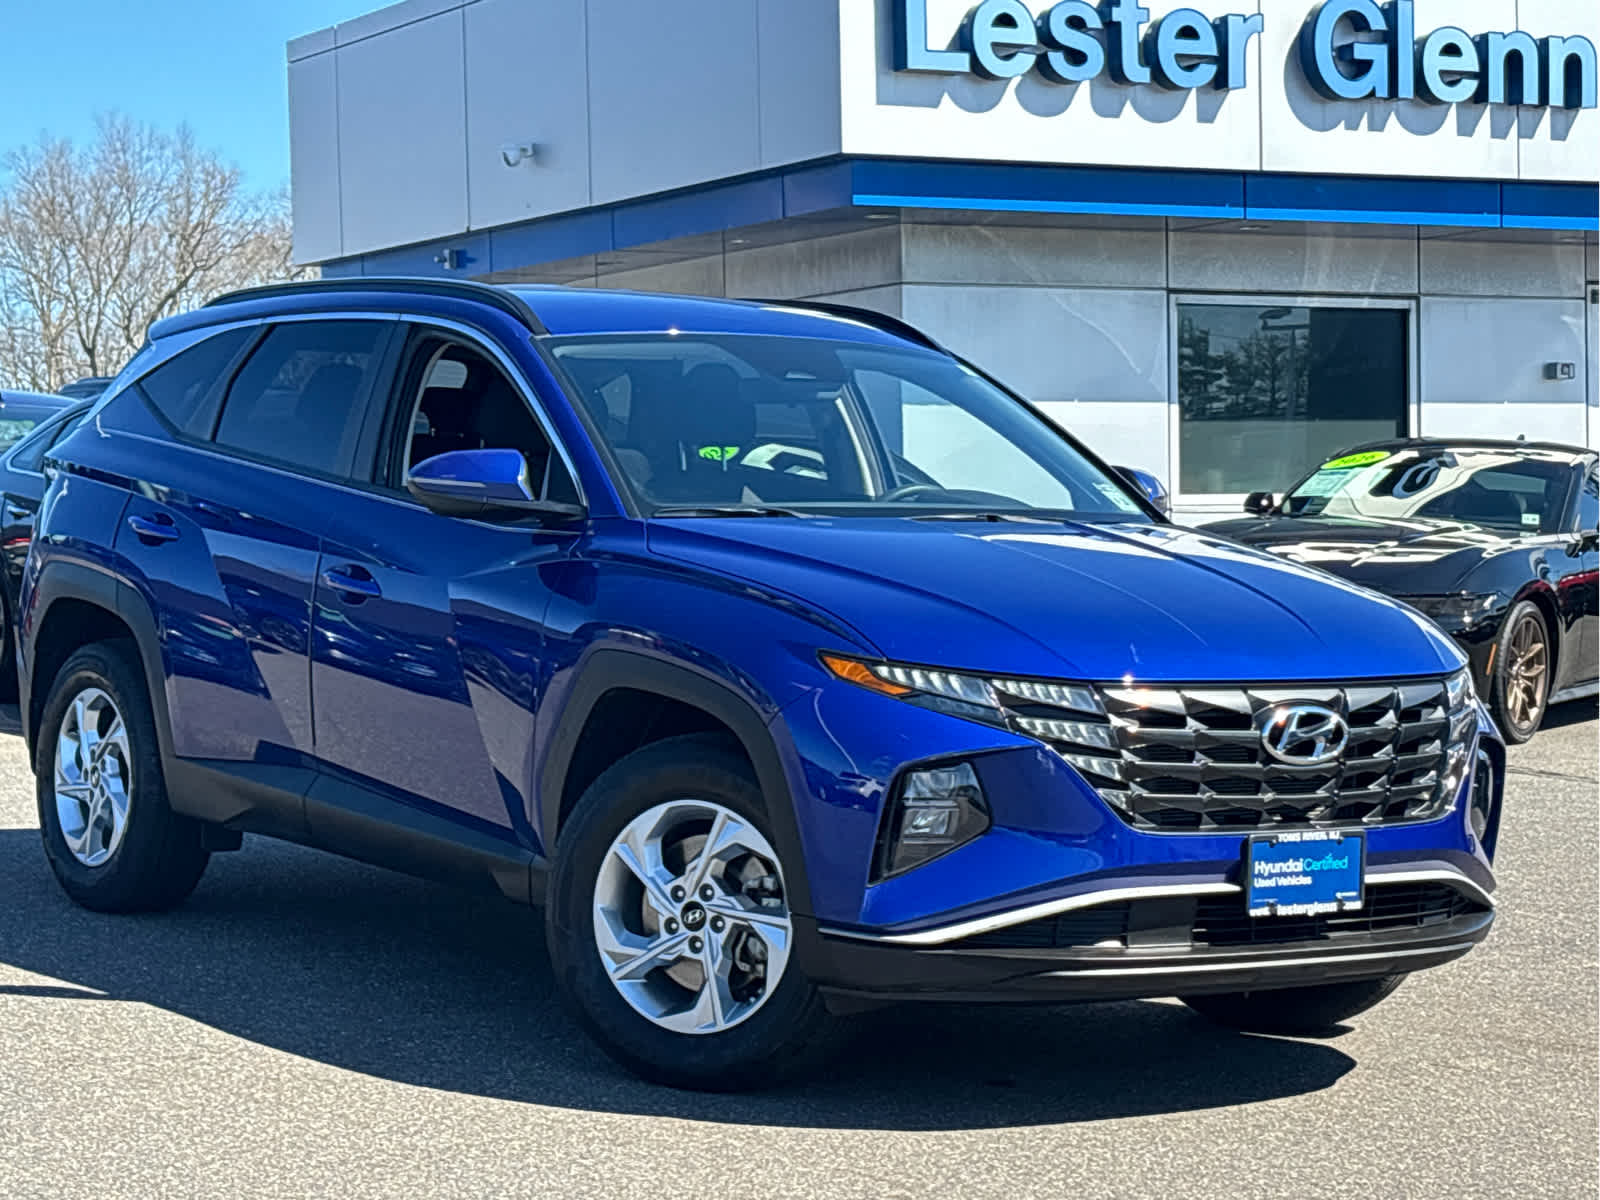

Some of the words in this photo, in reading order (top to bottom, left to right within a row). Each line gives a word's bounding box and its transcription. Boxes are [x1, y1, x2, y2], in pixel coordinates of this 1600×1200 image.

[903, 0, 1264, 89] Lester
[1311, 0, 1598, 109] Glenn
[1254, 877, 1276, 888] Used
[1277, 875, 1312, 886] Vehicles
